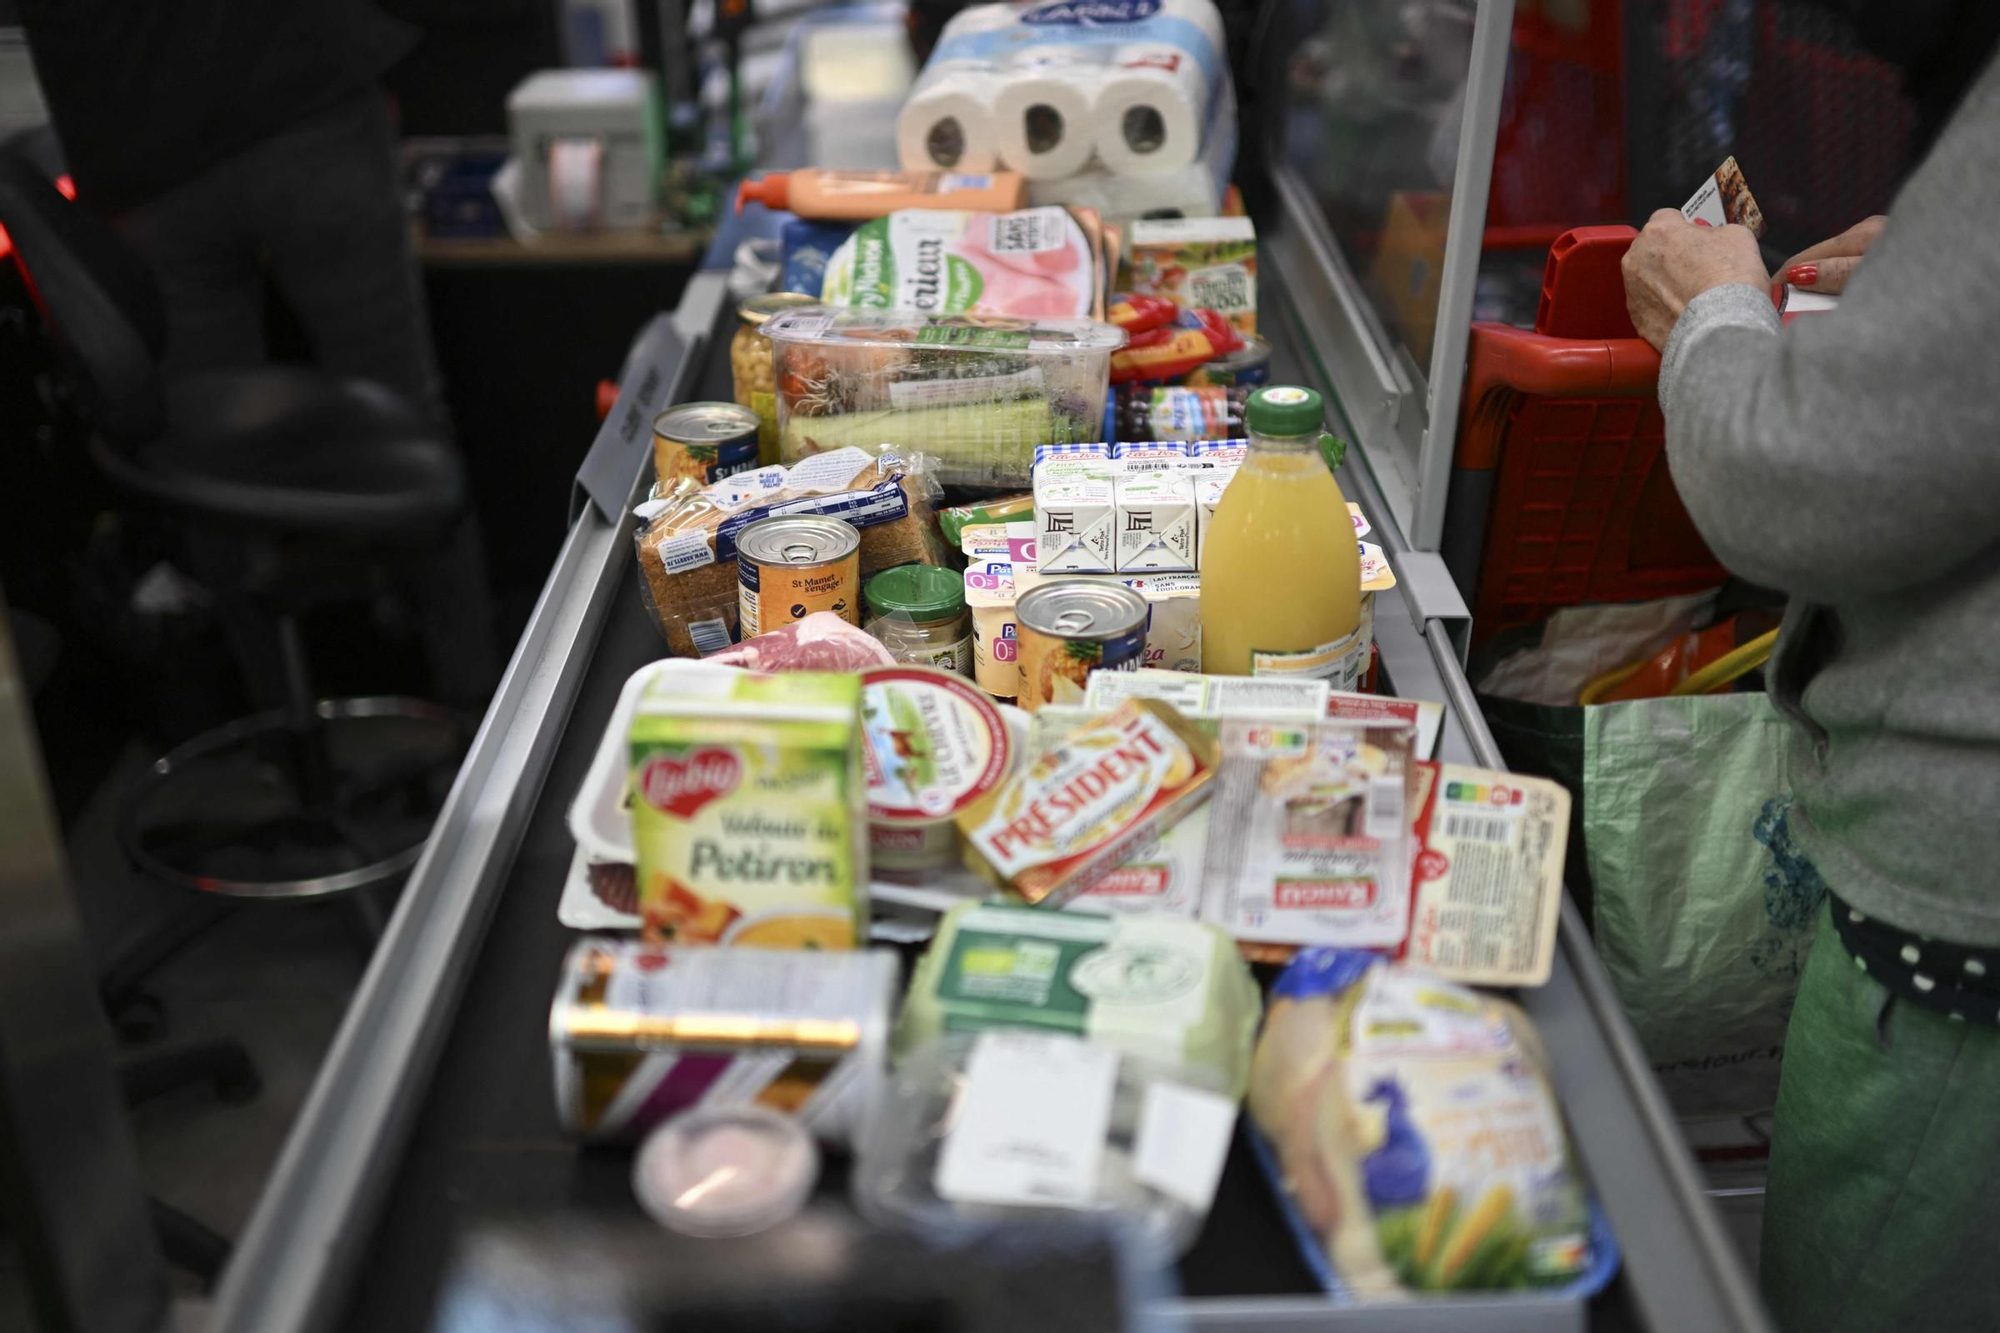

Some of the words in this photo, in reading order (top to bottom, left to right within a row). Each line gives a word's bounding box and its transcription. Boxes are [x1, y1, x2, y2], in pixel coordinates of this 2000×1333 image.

[792, 579, 802, 588] St
[804, 573, 836, 587] Mamet
[988, 729, 1165, 861] PRÉSIDENT
[689, 842, 844, 886] Potiron
